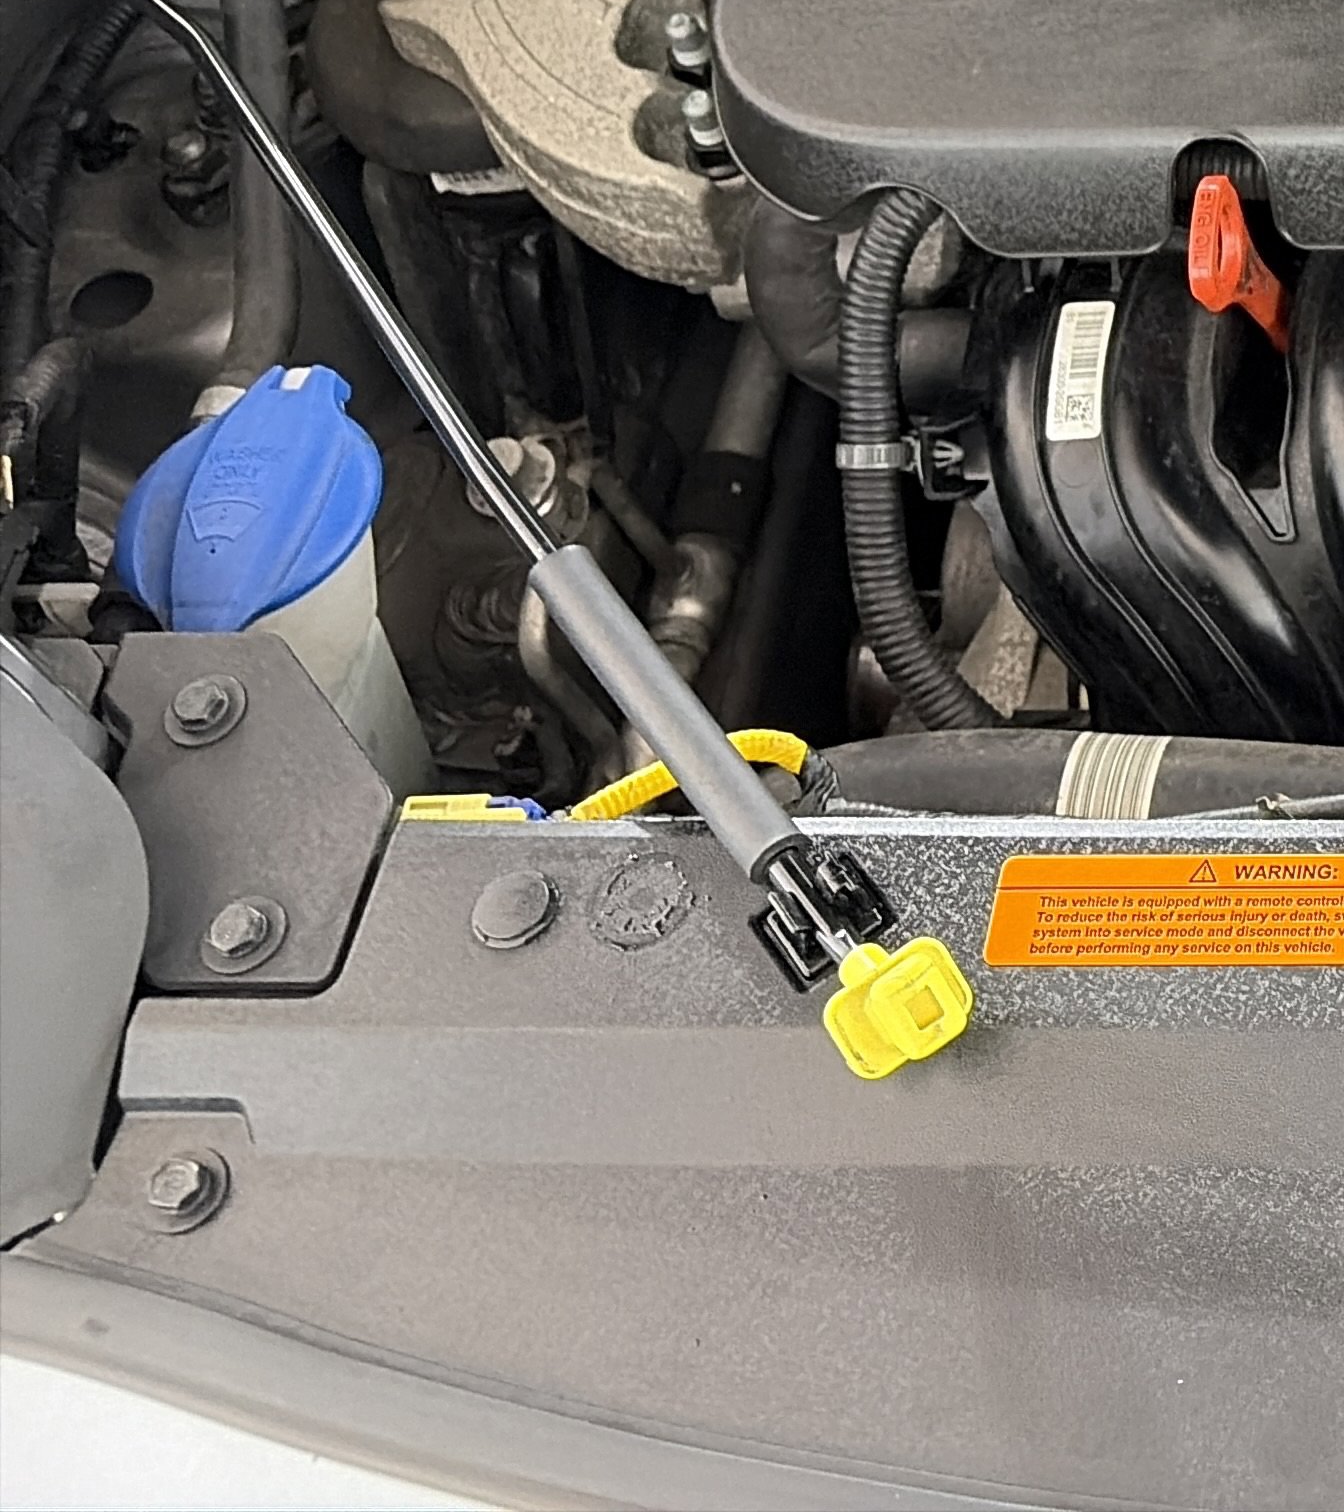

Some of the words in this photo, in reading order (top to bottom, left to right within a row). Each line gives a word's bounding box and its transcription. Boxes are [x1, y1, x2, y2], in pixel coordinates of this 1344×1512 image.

[1197, 191, 1214, 226] ENG
[1193, 234, 1211, 265] OIL
[1235, 864, 1339, 880] WARNING:
[1040, 896, 1067, 907] This
[1071, 896, 1119, 907] vehicle
[1122, 896, 1133, 907] is
[1138, 896, 1200, 909] equipped
[1203, 895, 1231, 907] with
[1235, 898, 1242, 907] a
[1246, 896, 1293, 907] remote
[1037, 911, 1054, 923] To
[1057, 911, 1103, 922] reduce
[1106, 911, 1127, 922] the
[1131, 911, 1156, 922] risk
[1159, 911, 1175, 922] of
[1177, 911, 1225, 922] serious
[1230, 910, 1268, 924] injury
[1271, 913, 1286, 921] or
[1289, 910, 1330, 923] death,
[1032, 927, 1081, 941] system
[1085, 925, 1111, 937] into
[1114, 926, 1163, 937] service
[1166, 926, 1203, 937] mode
[1207, 926, 1233, 937] and
[1236, 926, 1311, 937] disconnect
[1313, 926, 1335, 937] the
[1029, 942, 1073, 954] before
[1076, 942, 1151, 956] performing
[1154, 944, 1179, 956] any
[1182, 942, 1231, 953] service
[1234, 944, 1251, 953] on
[1256, 942, 1280, 953] this
[1284, 942, 1336, 953] vehicle.
